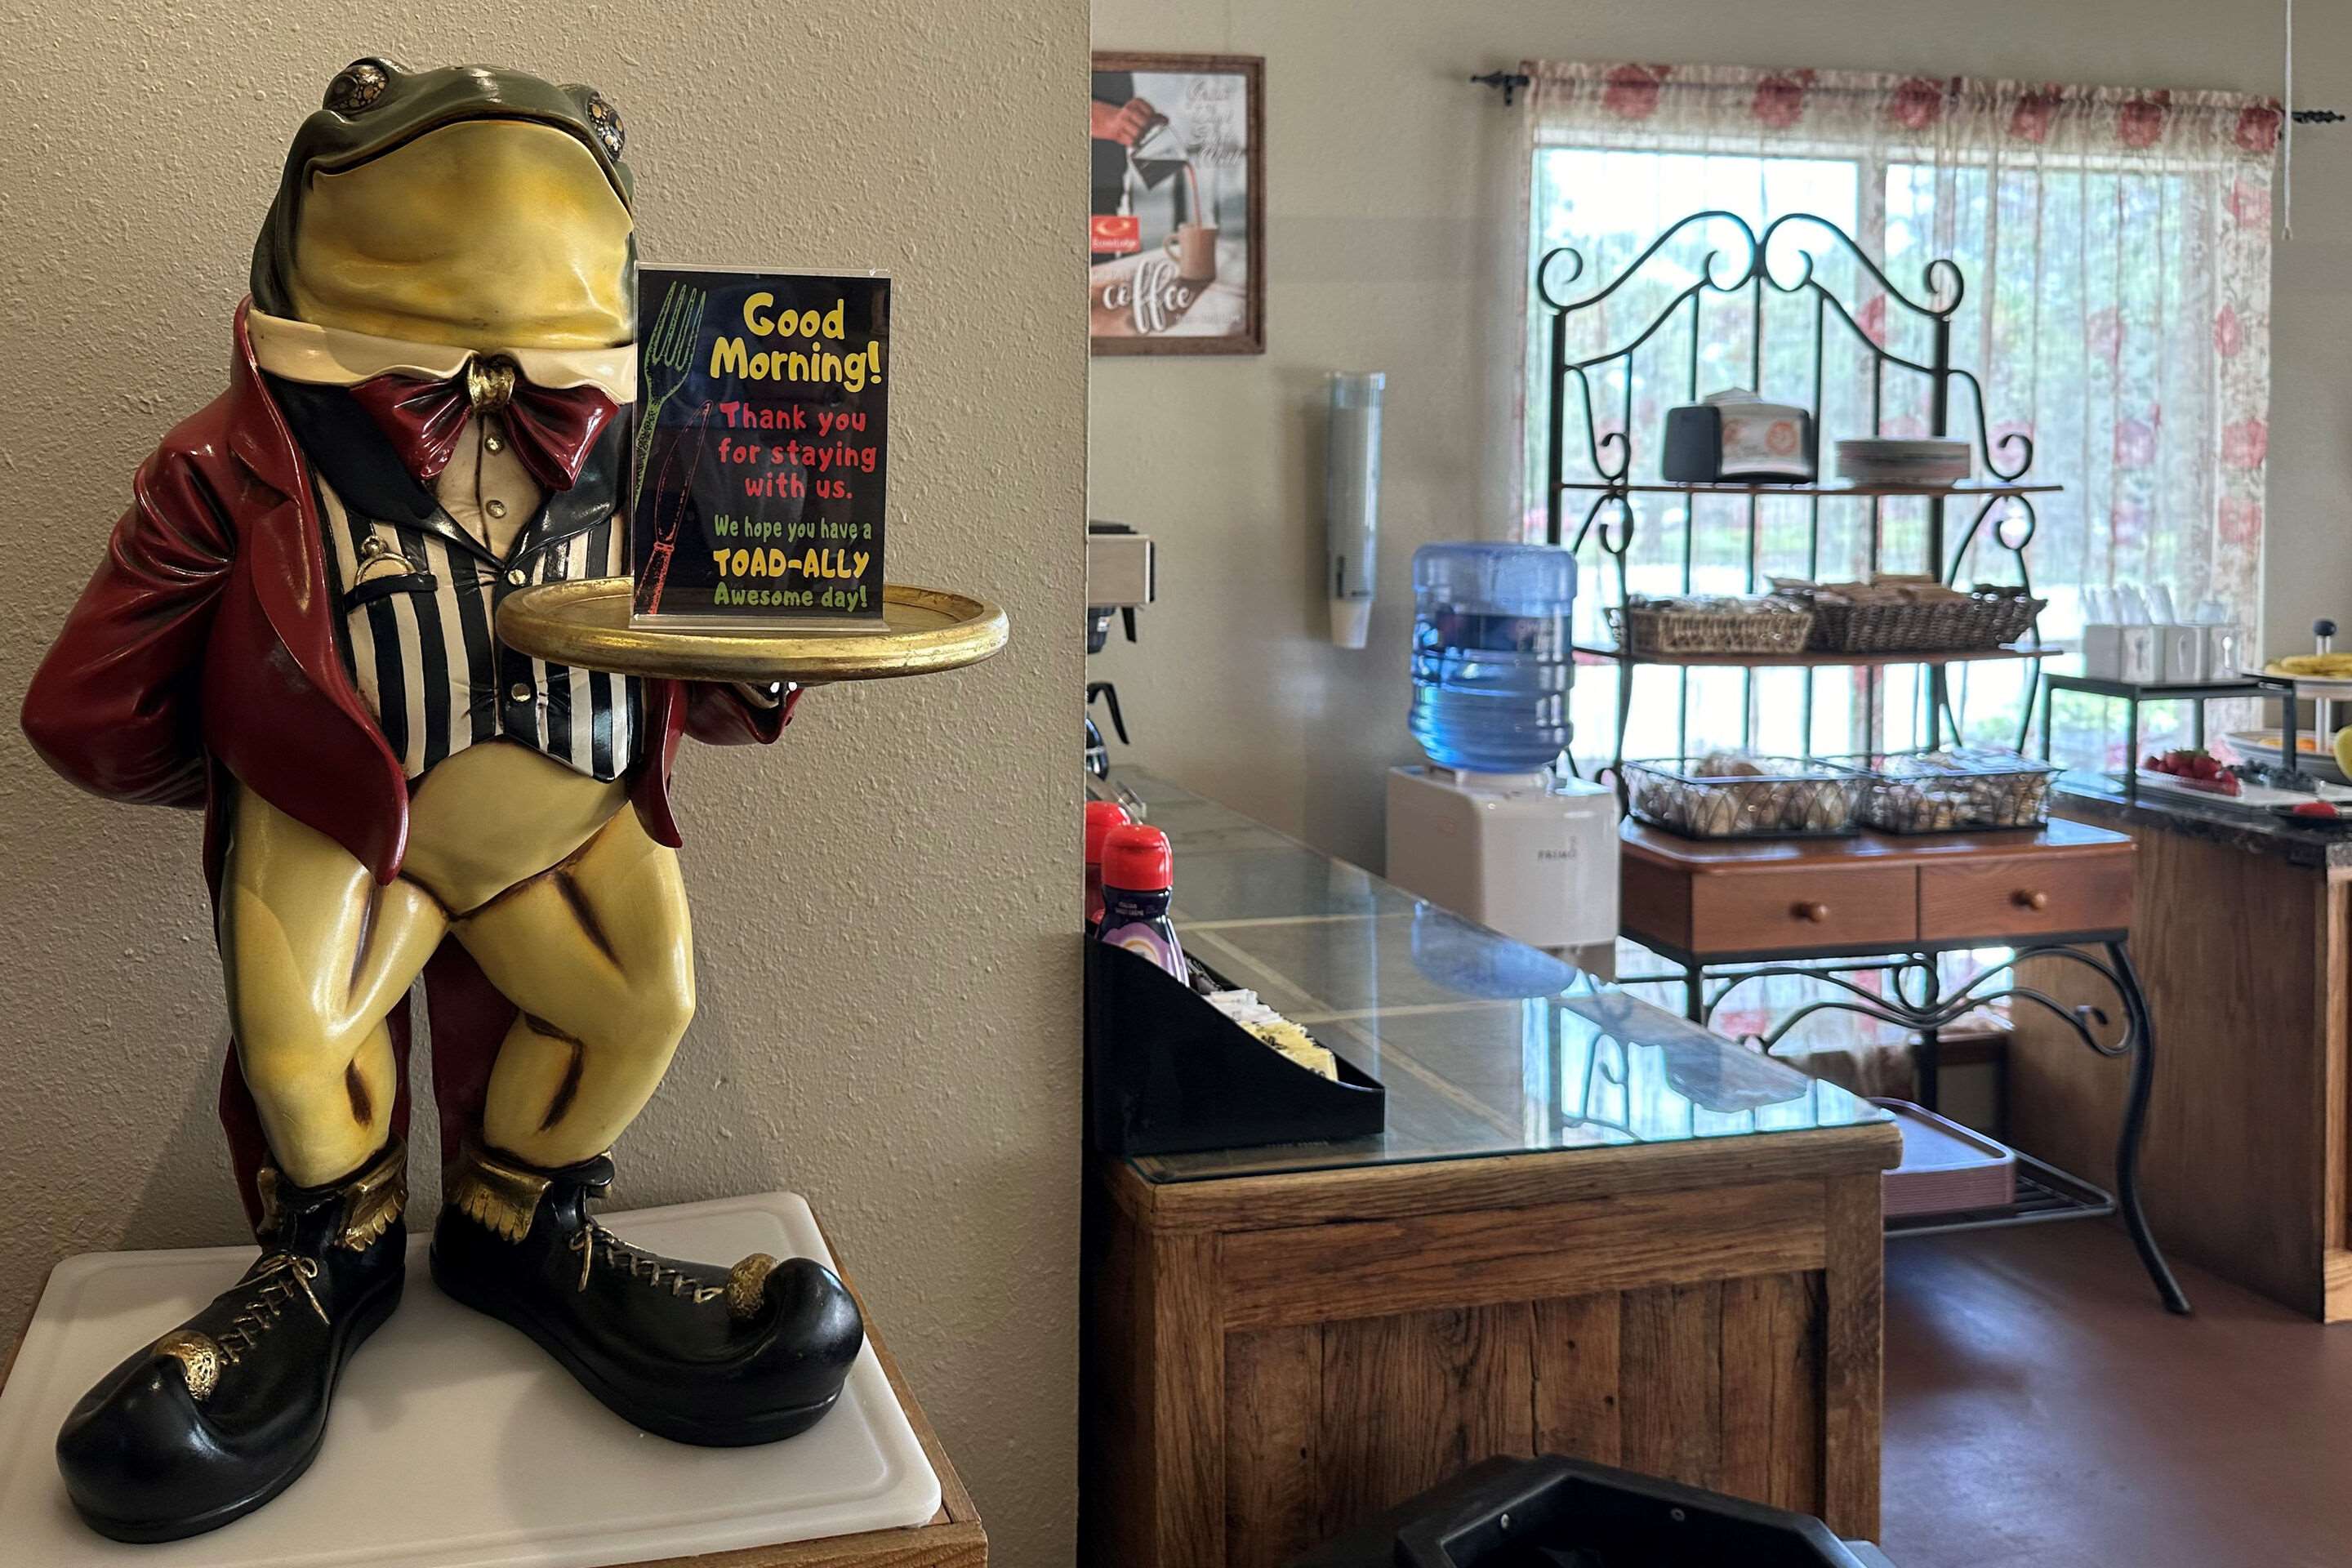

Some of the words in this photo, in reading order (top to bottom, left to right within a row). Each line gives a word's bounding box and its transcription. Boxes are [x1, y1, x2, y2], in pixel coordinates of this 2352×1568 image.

[1102, 260, 1192, 335] coffee
[742, 291, 845, 341] Good
[709, 336, 882, 393] Morning!
[719, 400, 807, 430] Thank
[817, 411, 866, 437] you
[718, 437, 761, 465] for
[770, 439, 877, 473] staying
[744, 471, 806, 498] with
[816, 479, 853, 500] us.
[714, 514, 739, 537] We
[744, 515, 782, 542] hope
[787, 520, 816, 542] you
[820, 517, 860, 540] have
[862, 520, 872, 540] a
[712, 546, 870, 579] TOAD-ALLY
[713, 581, 813, 607] Awesome
[821, 586, 868, 612] day!
